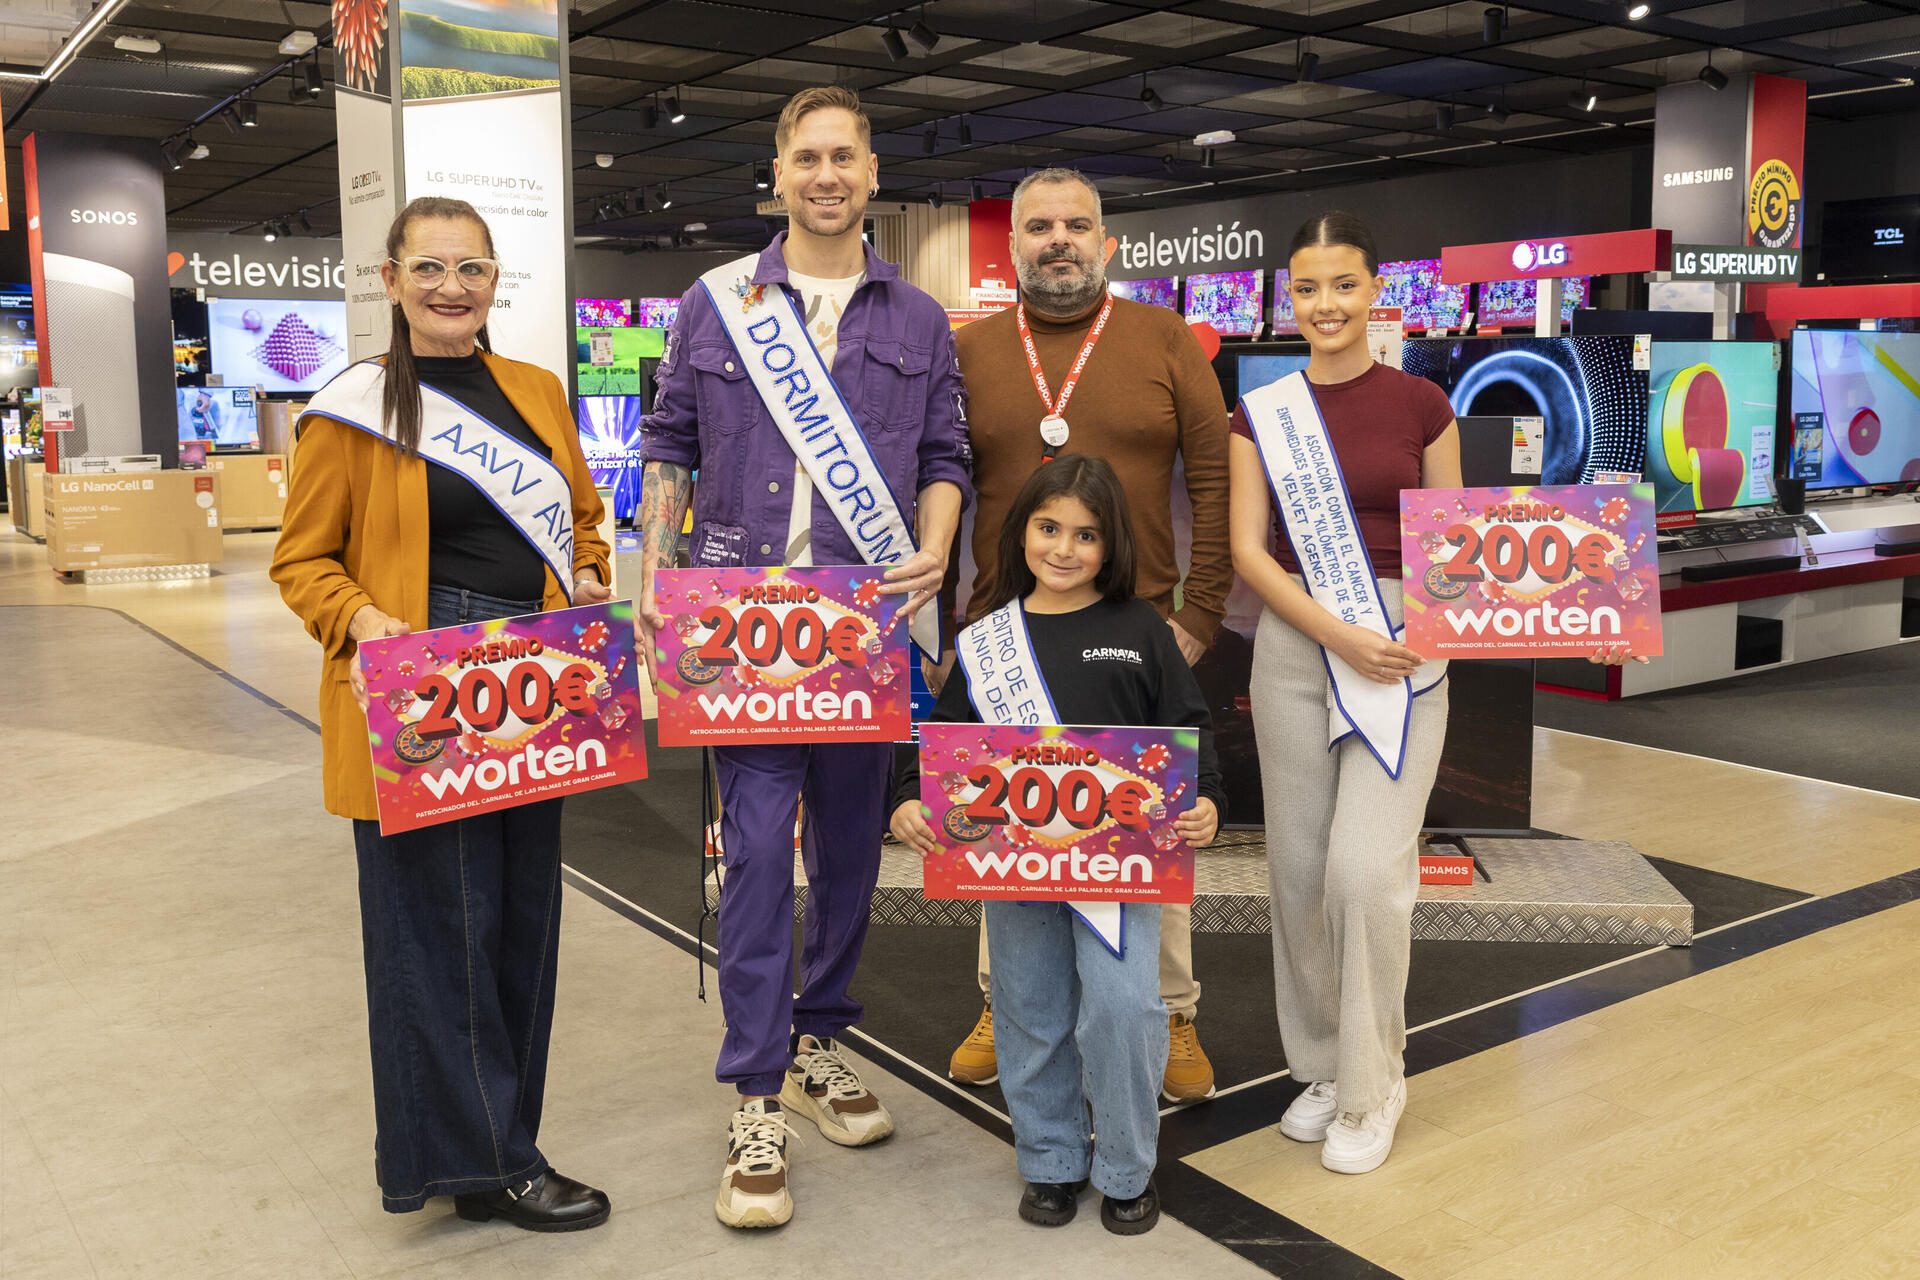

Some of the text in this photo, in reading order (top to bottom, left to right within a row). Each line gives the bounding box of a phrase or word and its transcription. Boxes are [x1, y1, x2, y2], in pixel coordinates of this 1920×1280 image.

[427, 170, 444, 182] LG
[518, 178, 536, 190] TV
[1663, 166, 1734, 187] SAMSUNG
[1751, 162, 1792, 213] PRECIO MÍNIMO
[70, 209, 138, 226] SONOS
[511, 205, 524, 216] del
[527, 208, 548, 218] color
[1759, 204, 1796, 248] GARANTIZADO
[1120, 221, 1264, 269] televisión
[1874, 228, 1904, 240] TCL
[1538, 243, 1567, 265] LG
[1675, 252, 1696, 274] LG
[1778, 255, 1799, 275] TV
[1092, 304, 1112, 336] worten
[1024, 335, 1038, 368] worten
[1072, 341, 1095, 374] worten
[1036, 372, 1052, 409] worten
[1054, 380, 1076, 416] worten
[430, 423, 543, 496] AAVV
[61, 482, 79, 493] LG
[83, 479, 140, 493] NanoCell
[1276, 406, 1308, 471] ENFERMEDADES
[1300, 474, 1321, 511] RARAS
[1335, 587, 1350, 604] DE
[1484, 503, 1565, 523] PREMIO
[1281, 472, 1328, 589] VELVET AGENCY
[1304, 434, 1373, 616] ASOCIACIÓN CONTRA EL CANCER Y
[1442, 523, 1617, 584] 200€
[739, 584, 820, 605] PREMIO
[1444, 600, 1621, 636] worten
[457, 636, 544, 669] PREMIO
[697, 606, 868, 668] 200€
[1082, 647, 1142, 661] CARNAVAL
[1004, 665, 1028, 697] DE
[413, 661, 598, 741] 200€
[697, 684, 872, 722] worten
[421, 738, 607, 800] worten
[1011, 745, 1100, 766] PREMIO
[416, 770, 617, 818] PATROCINADOR DEL CARNAVAL DE LAS PALMAS DE GRAN CANARIA
[965, 764, 1152, 832] 200€
[965, 846, 1152, 882] worten
[1421, 865, 1469, 875] NDAMOS
